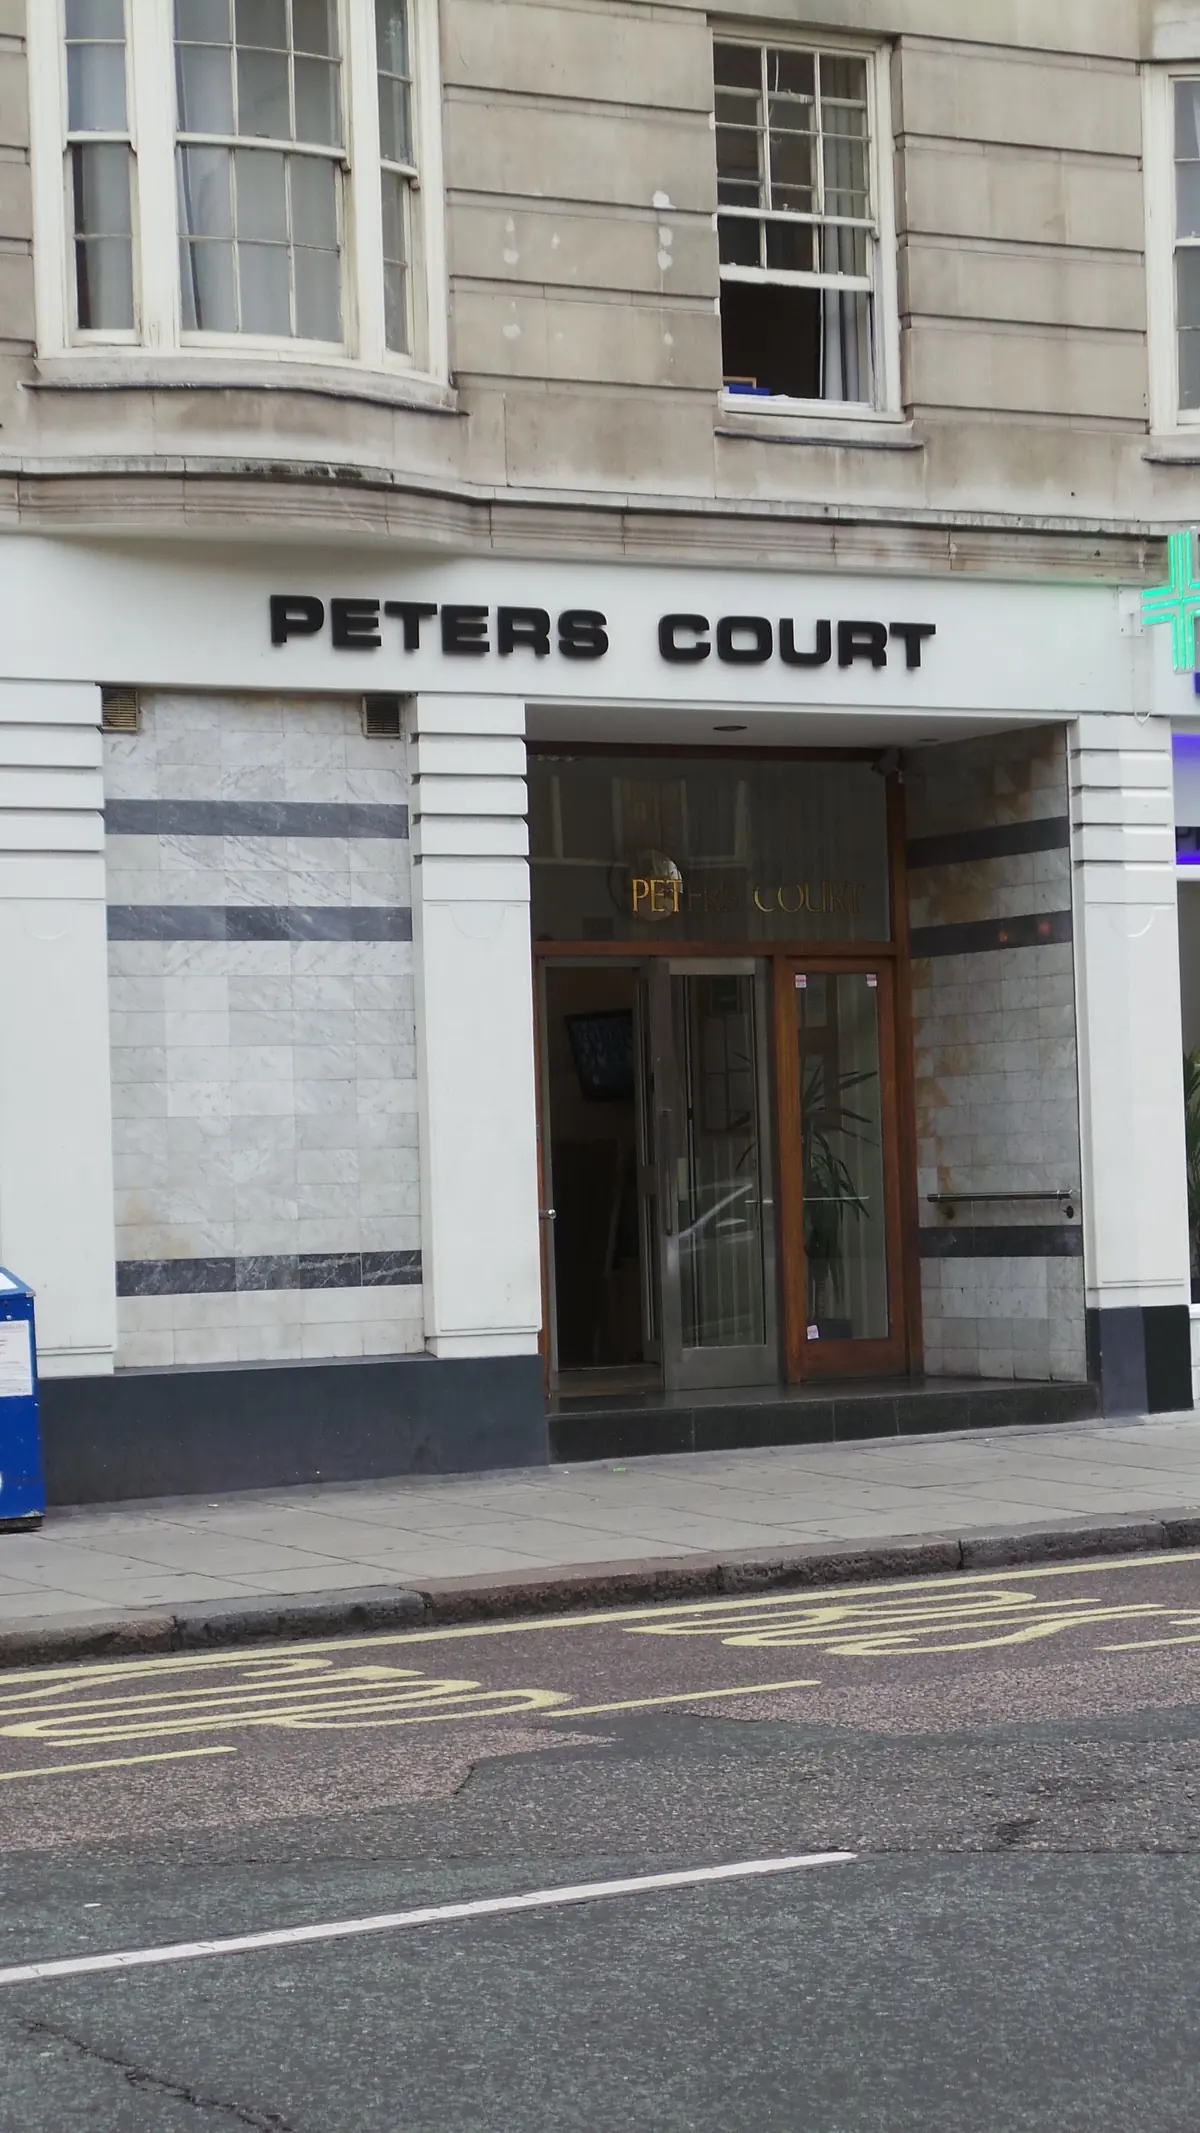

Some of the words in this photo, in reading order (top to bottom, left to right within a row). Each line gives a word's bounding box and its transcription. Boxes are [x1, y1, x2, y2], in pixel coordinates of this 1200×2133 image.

[270, 595, 608, 661] PETERS
[659, 615, 936, 669] COURT
[752, 880, 867, 914] COURT
[622, 1590, 1200, 1657] BUS
